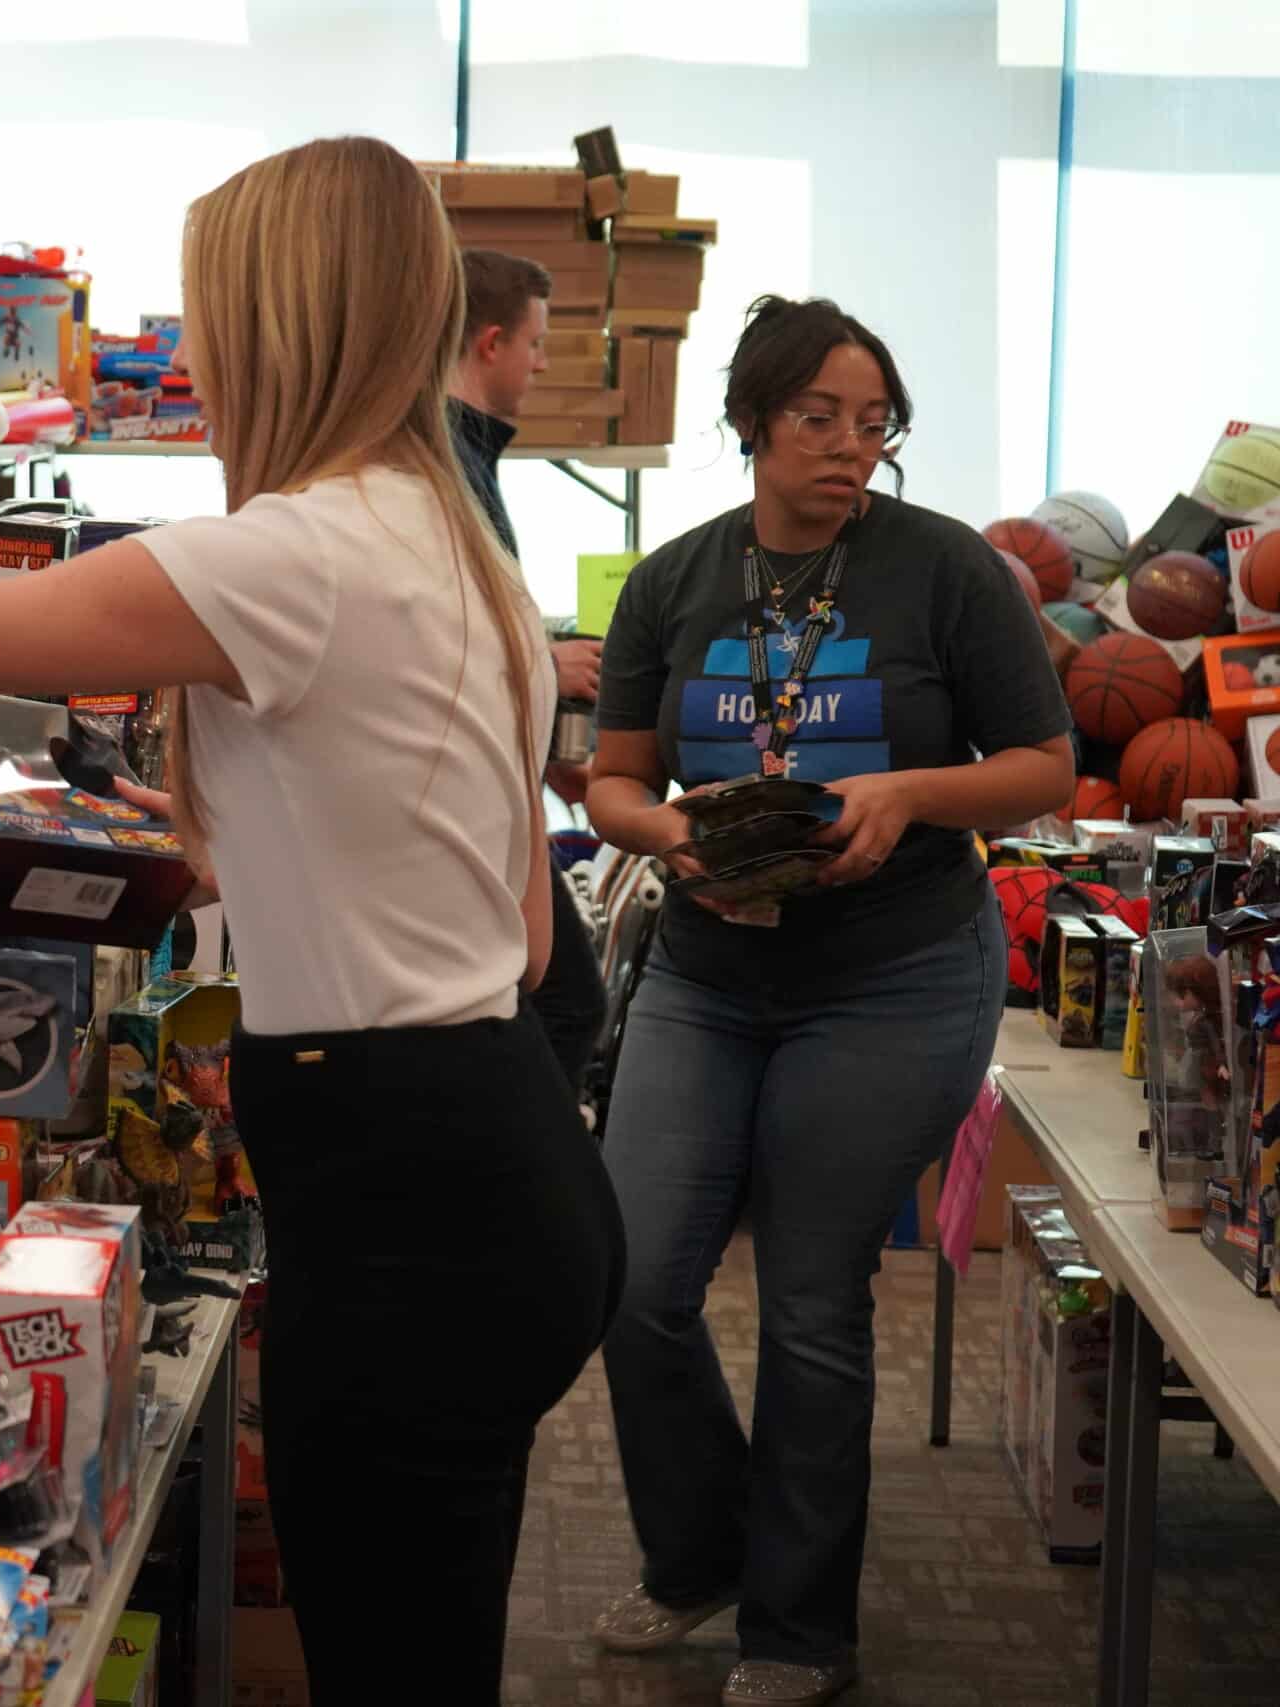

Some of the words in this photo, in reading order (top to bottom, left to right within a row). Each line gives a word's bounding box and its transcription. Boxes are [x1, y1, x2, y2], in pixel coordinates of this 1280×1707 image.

[717, 693, 842, 722] HODAY
[0, 1312, 60, 1342] TECH
[7, 1335, 79, 1361] DECK
